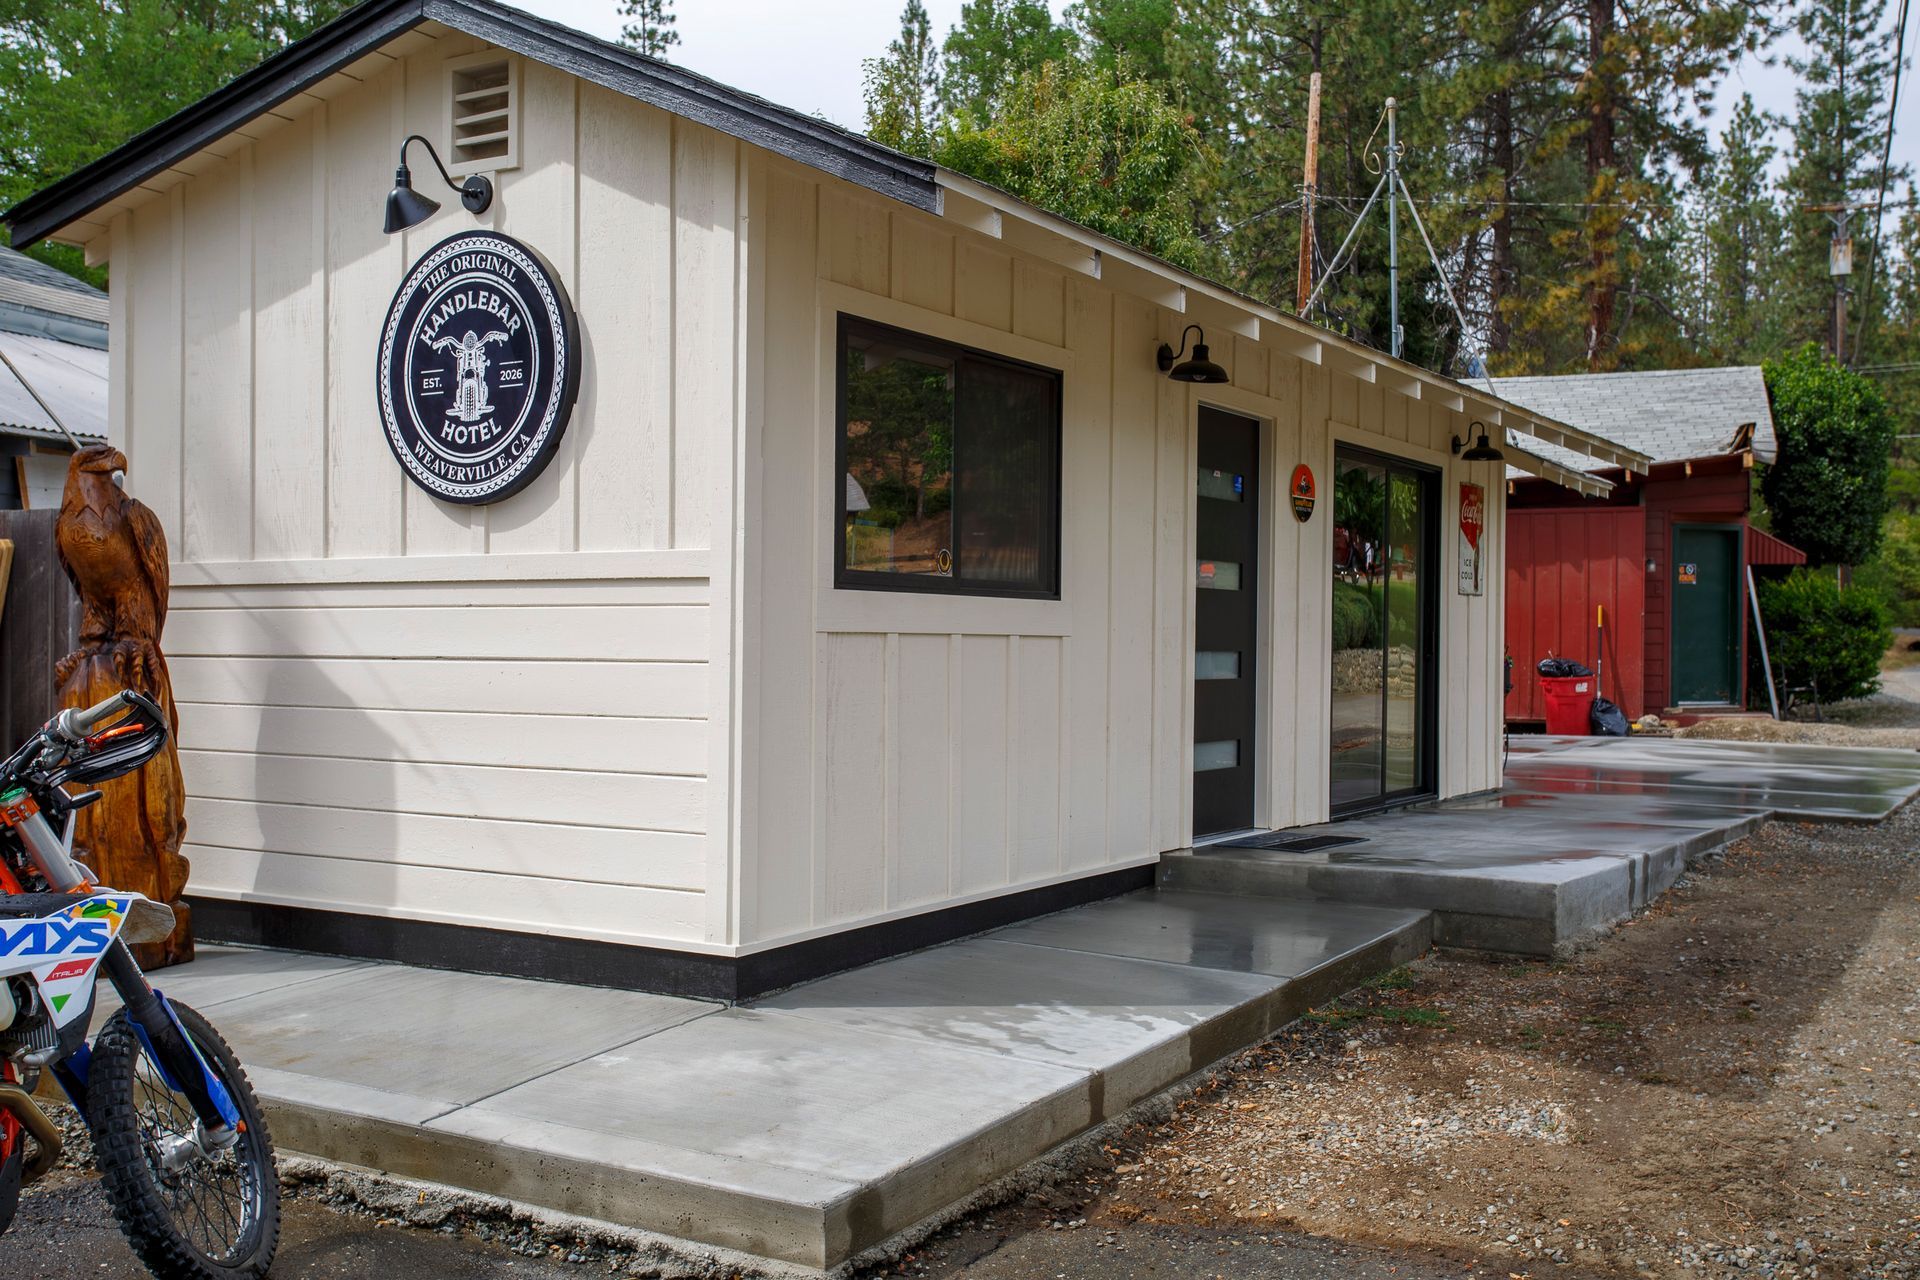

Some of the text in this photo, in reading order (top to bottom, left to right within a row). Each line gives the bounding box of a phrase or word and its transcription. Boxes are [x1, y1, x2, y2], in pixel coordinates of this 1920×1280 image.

[421, 254, 517, 294] THE ORIGINAL
[420, 290, 521, 346] HANDLEBAR
[423, 369, 523, 389] EST. 2026
[440, 417, 502, 445] HOTEL
[414, 433, 531, 481] WEAVERVILLE, CA
[1463, 558, 1472, 567] ICE
[1461, 571, 1473, 580] COLD
[52, 969, 84, 979] ITALIA
